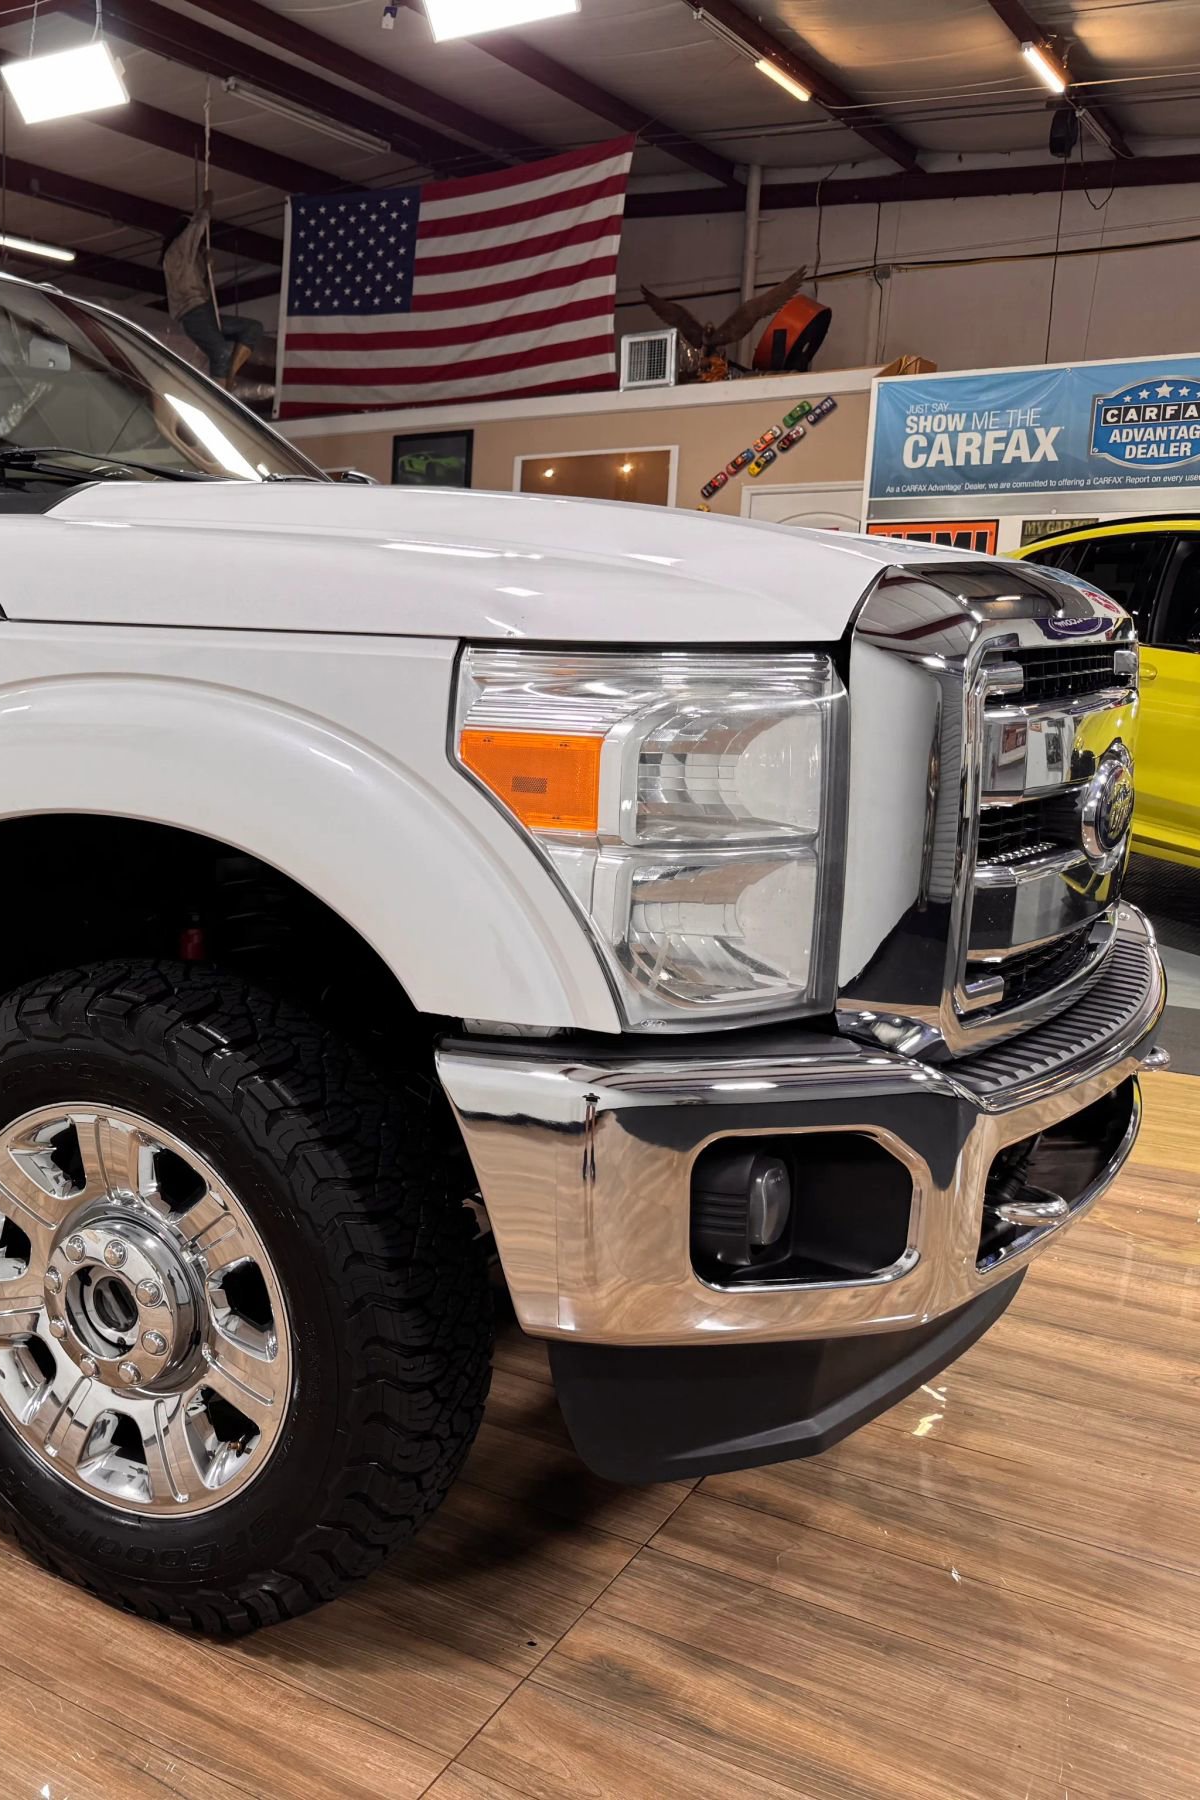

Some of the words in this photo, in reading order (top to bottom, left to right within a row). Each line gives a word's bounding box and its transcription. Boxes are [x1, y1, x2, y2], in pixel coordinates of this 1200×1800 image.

[906, 403, 929, 415] JUST
[931, 402, 949, 413] SAY
[905, 412, 967, 434] SHOW
[971, 410, 1001, 430] ME
[1006, 408, 1042, 428] THE
[902, 426, 1061, 469] CARFAX
[1124, 441, 1192, 459] DEALER
[901, 484, 927, 493] CARFAX
[964, 482, 987, 490] Dealer,
[1012, 480, 1048, 489] committed
[1049, 479, 1056, 487] to
[1058, 479, 1084, 487] offering
[1125, 475, 1150, 485] Report
[1163, 475, 1184, 484] every
[1025, 520, 1043, 535] MY
[1046, 517, 1097, 533] GAR
